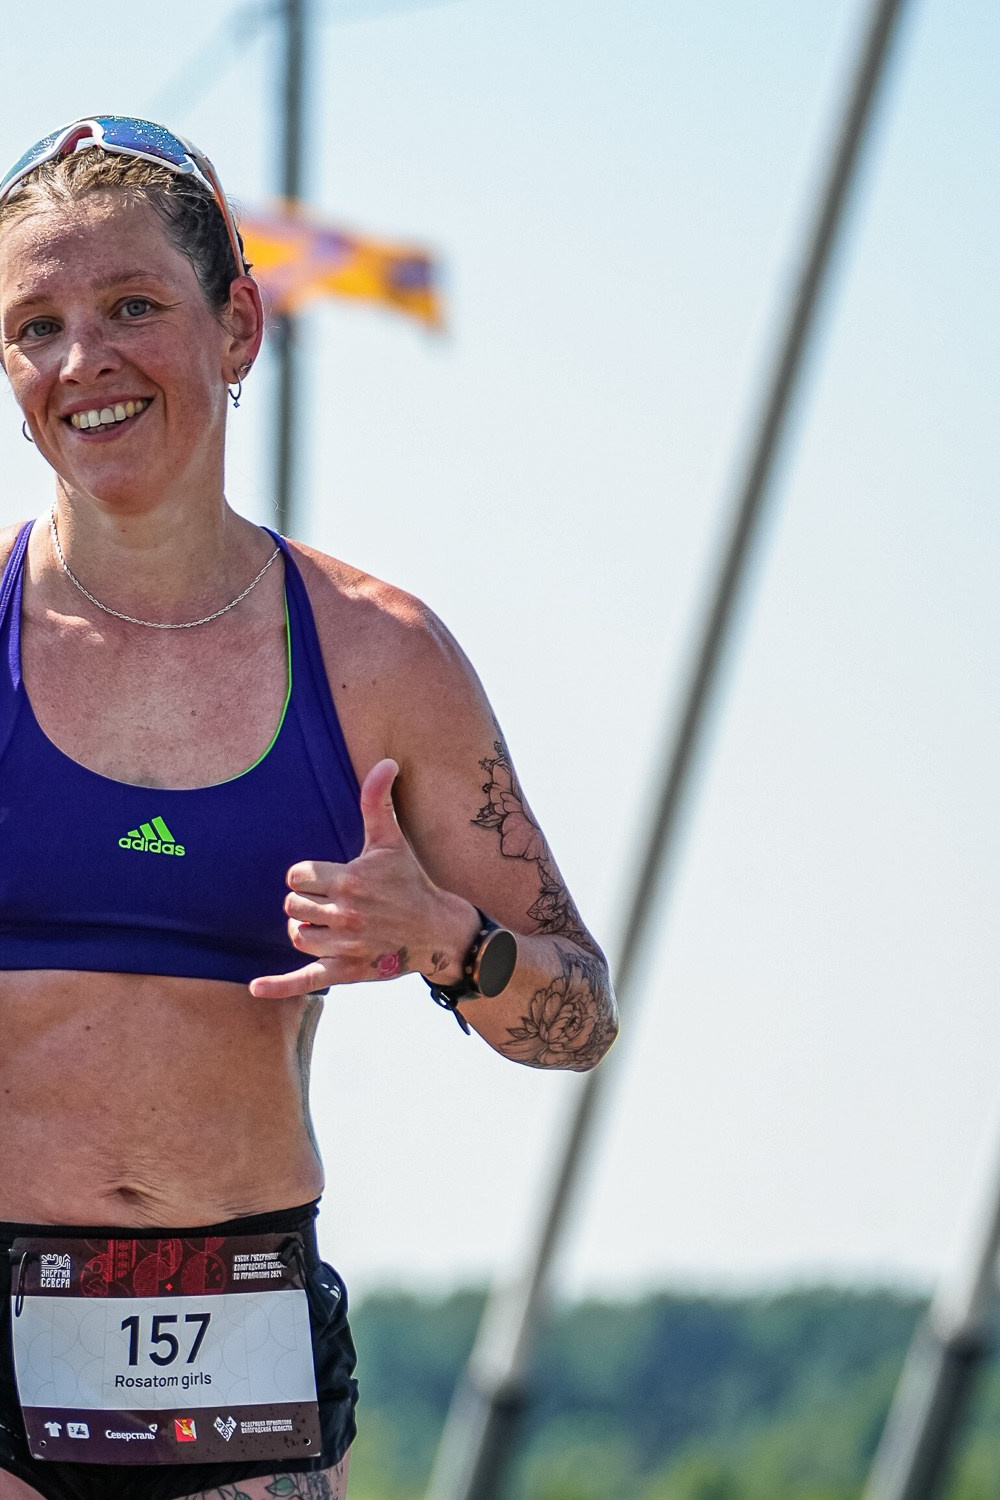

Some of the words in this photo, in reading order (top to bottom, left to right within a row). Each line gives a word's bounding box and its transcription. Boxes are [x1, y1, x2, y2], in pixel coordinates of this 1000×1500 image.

[118, 837, 186, 857] adidas
[40, 1269, 71, 1278] ЭНЕРГИЯ
[40, 1277, 71, 1289] СЕВЕРА
[120, 1312, 212, 1367] 157
[114, 1374, 179, 1388] Rosatom
[181, 1371, 212, 1390] girls
[105, 1429, 156, 1442] Северсталь
